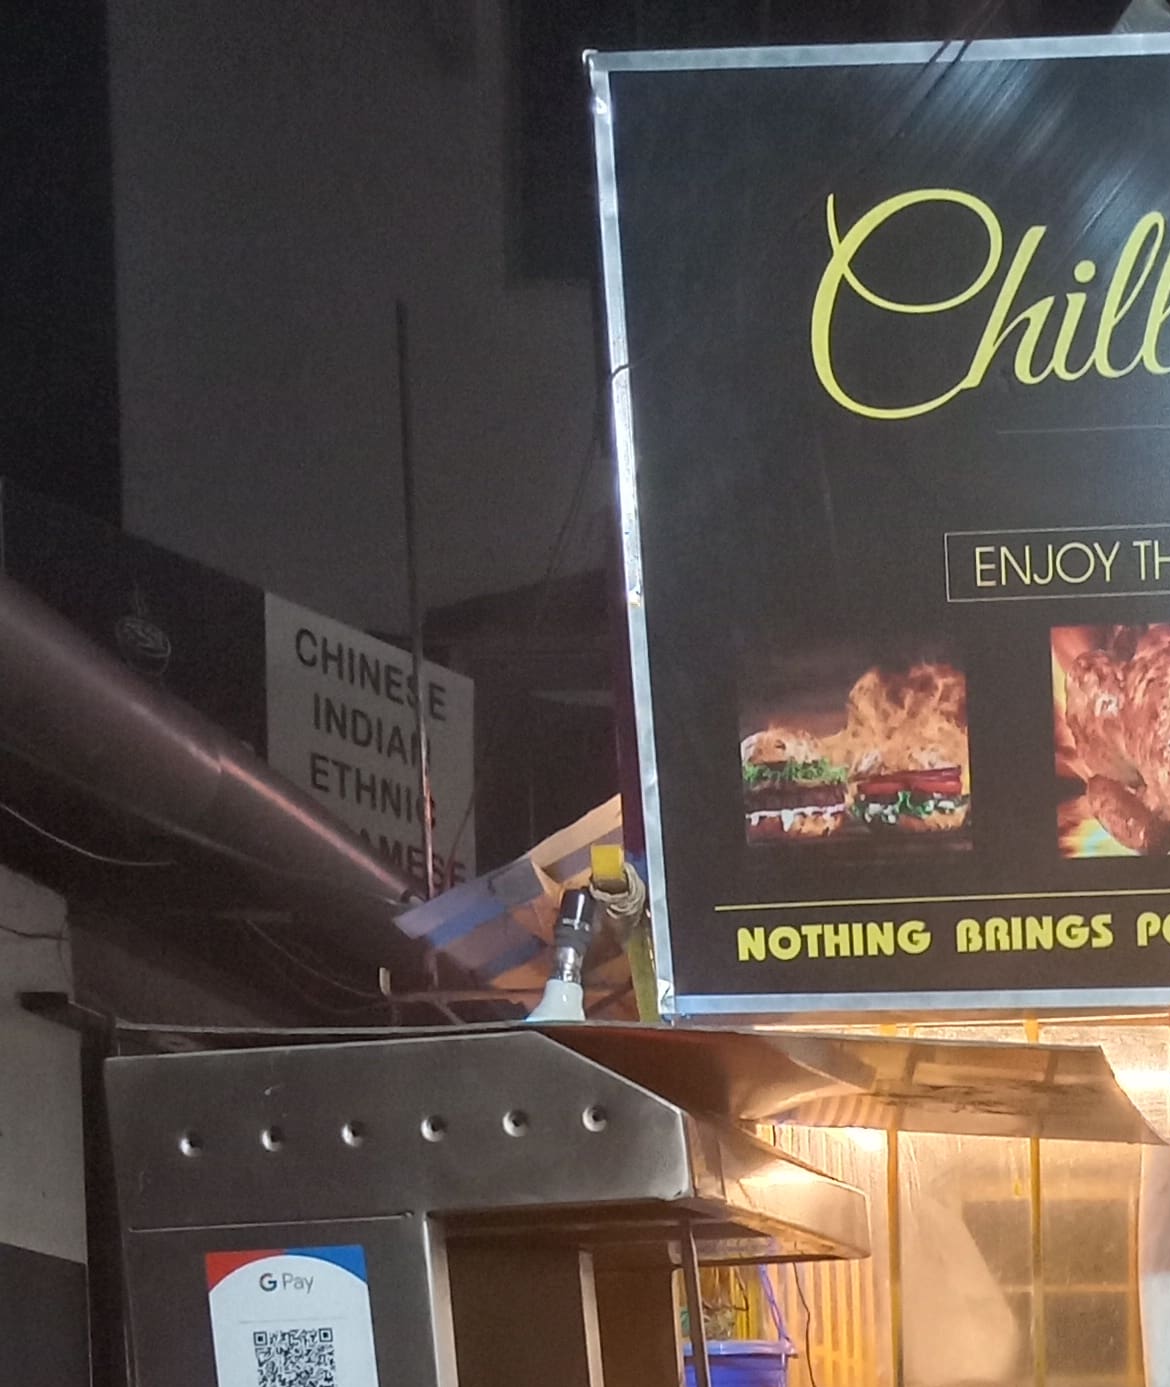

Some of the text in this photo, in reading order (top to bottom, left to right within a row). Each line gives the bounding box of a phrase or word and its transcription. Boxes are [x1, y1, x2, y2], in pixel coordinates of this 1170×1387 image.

[974, 541, 1120, 587] ENJOY
[313, 692, 431, 768] INDIAN
[736, 920, 932, 962] NOTHING
[955, 913, 1114, 953] BRINGS
[281, 1272, 315, 1294] Pay
